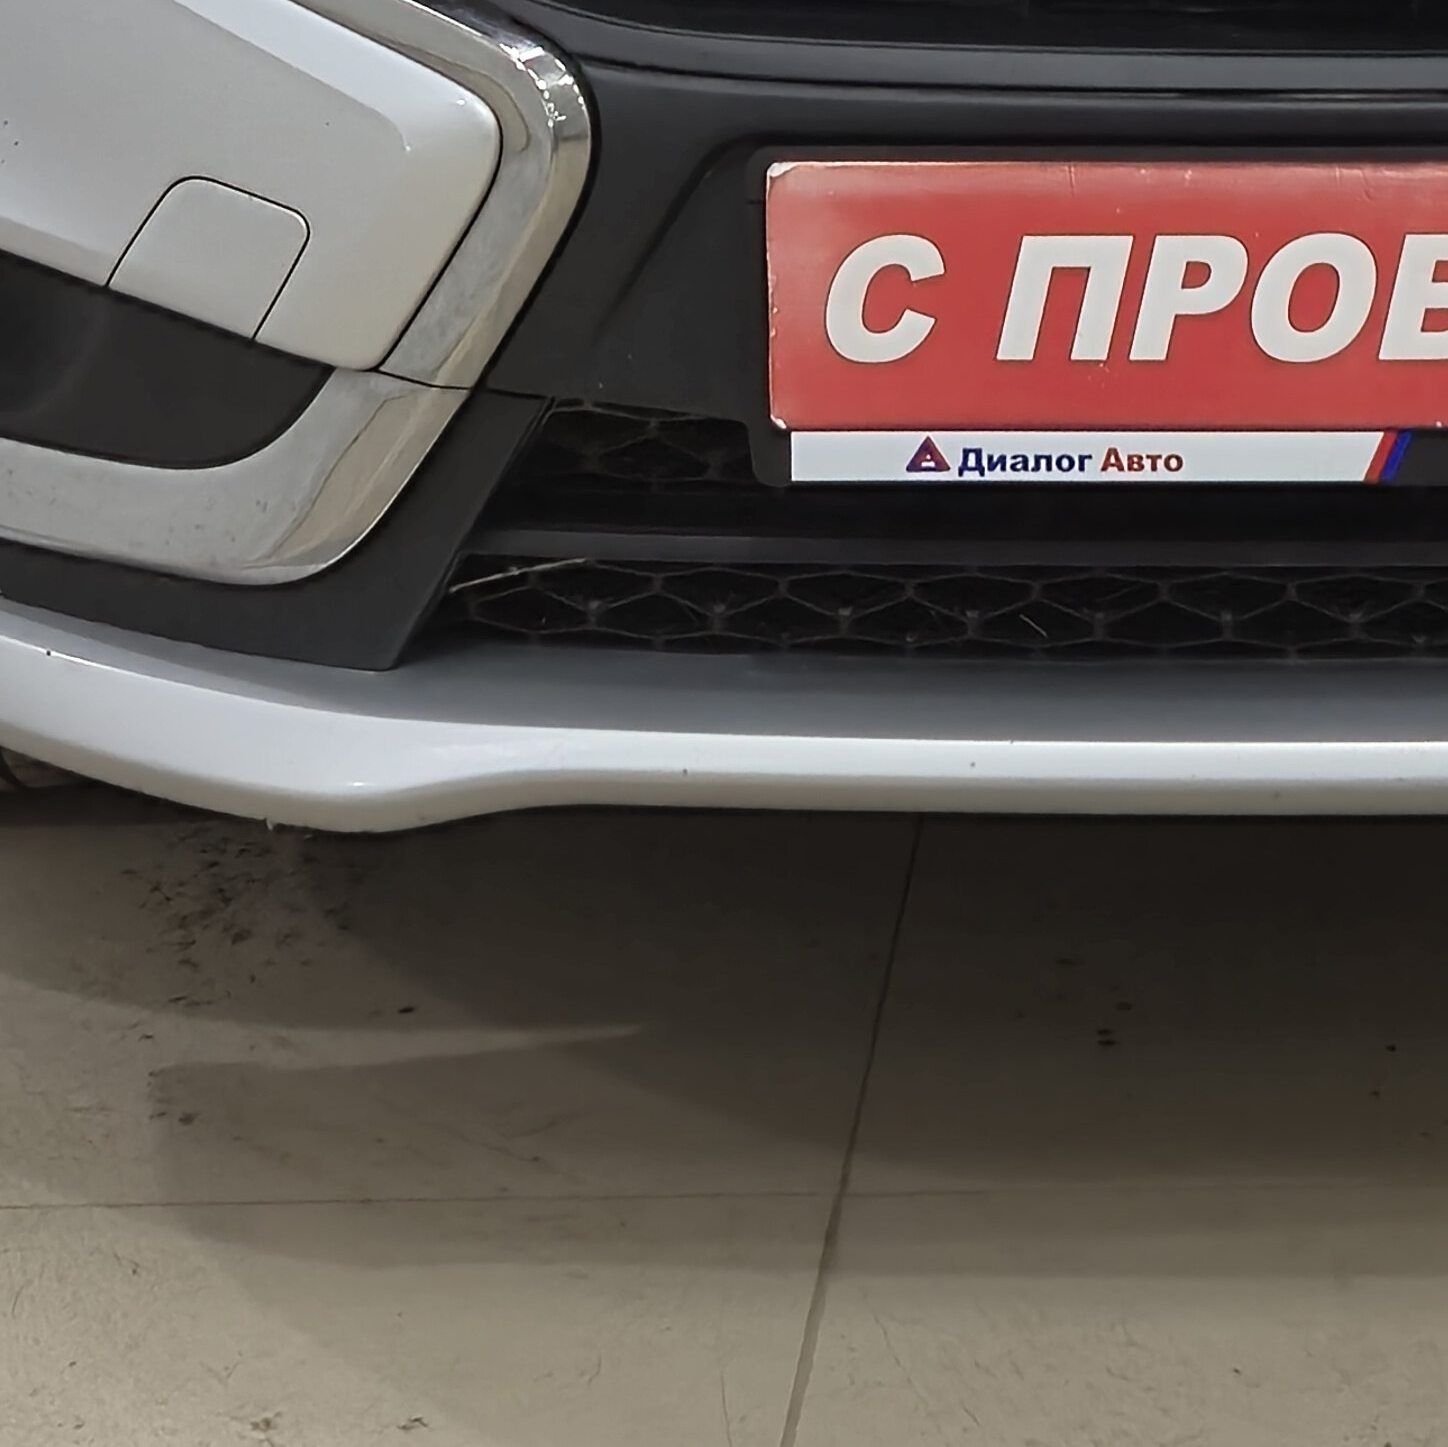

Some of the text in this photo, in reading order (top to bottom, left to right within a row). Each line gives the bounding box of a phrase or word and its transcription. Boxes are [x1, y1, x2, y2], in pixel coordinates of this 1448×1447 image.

[823, 233, 946, 363] С
[957, 447, 1185, 478] Диалог Авто
